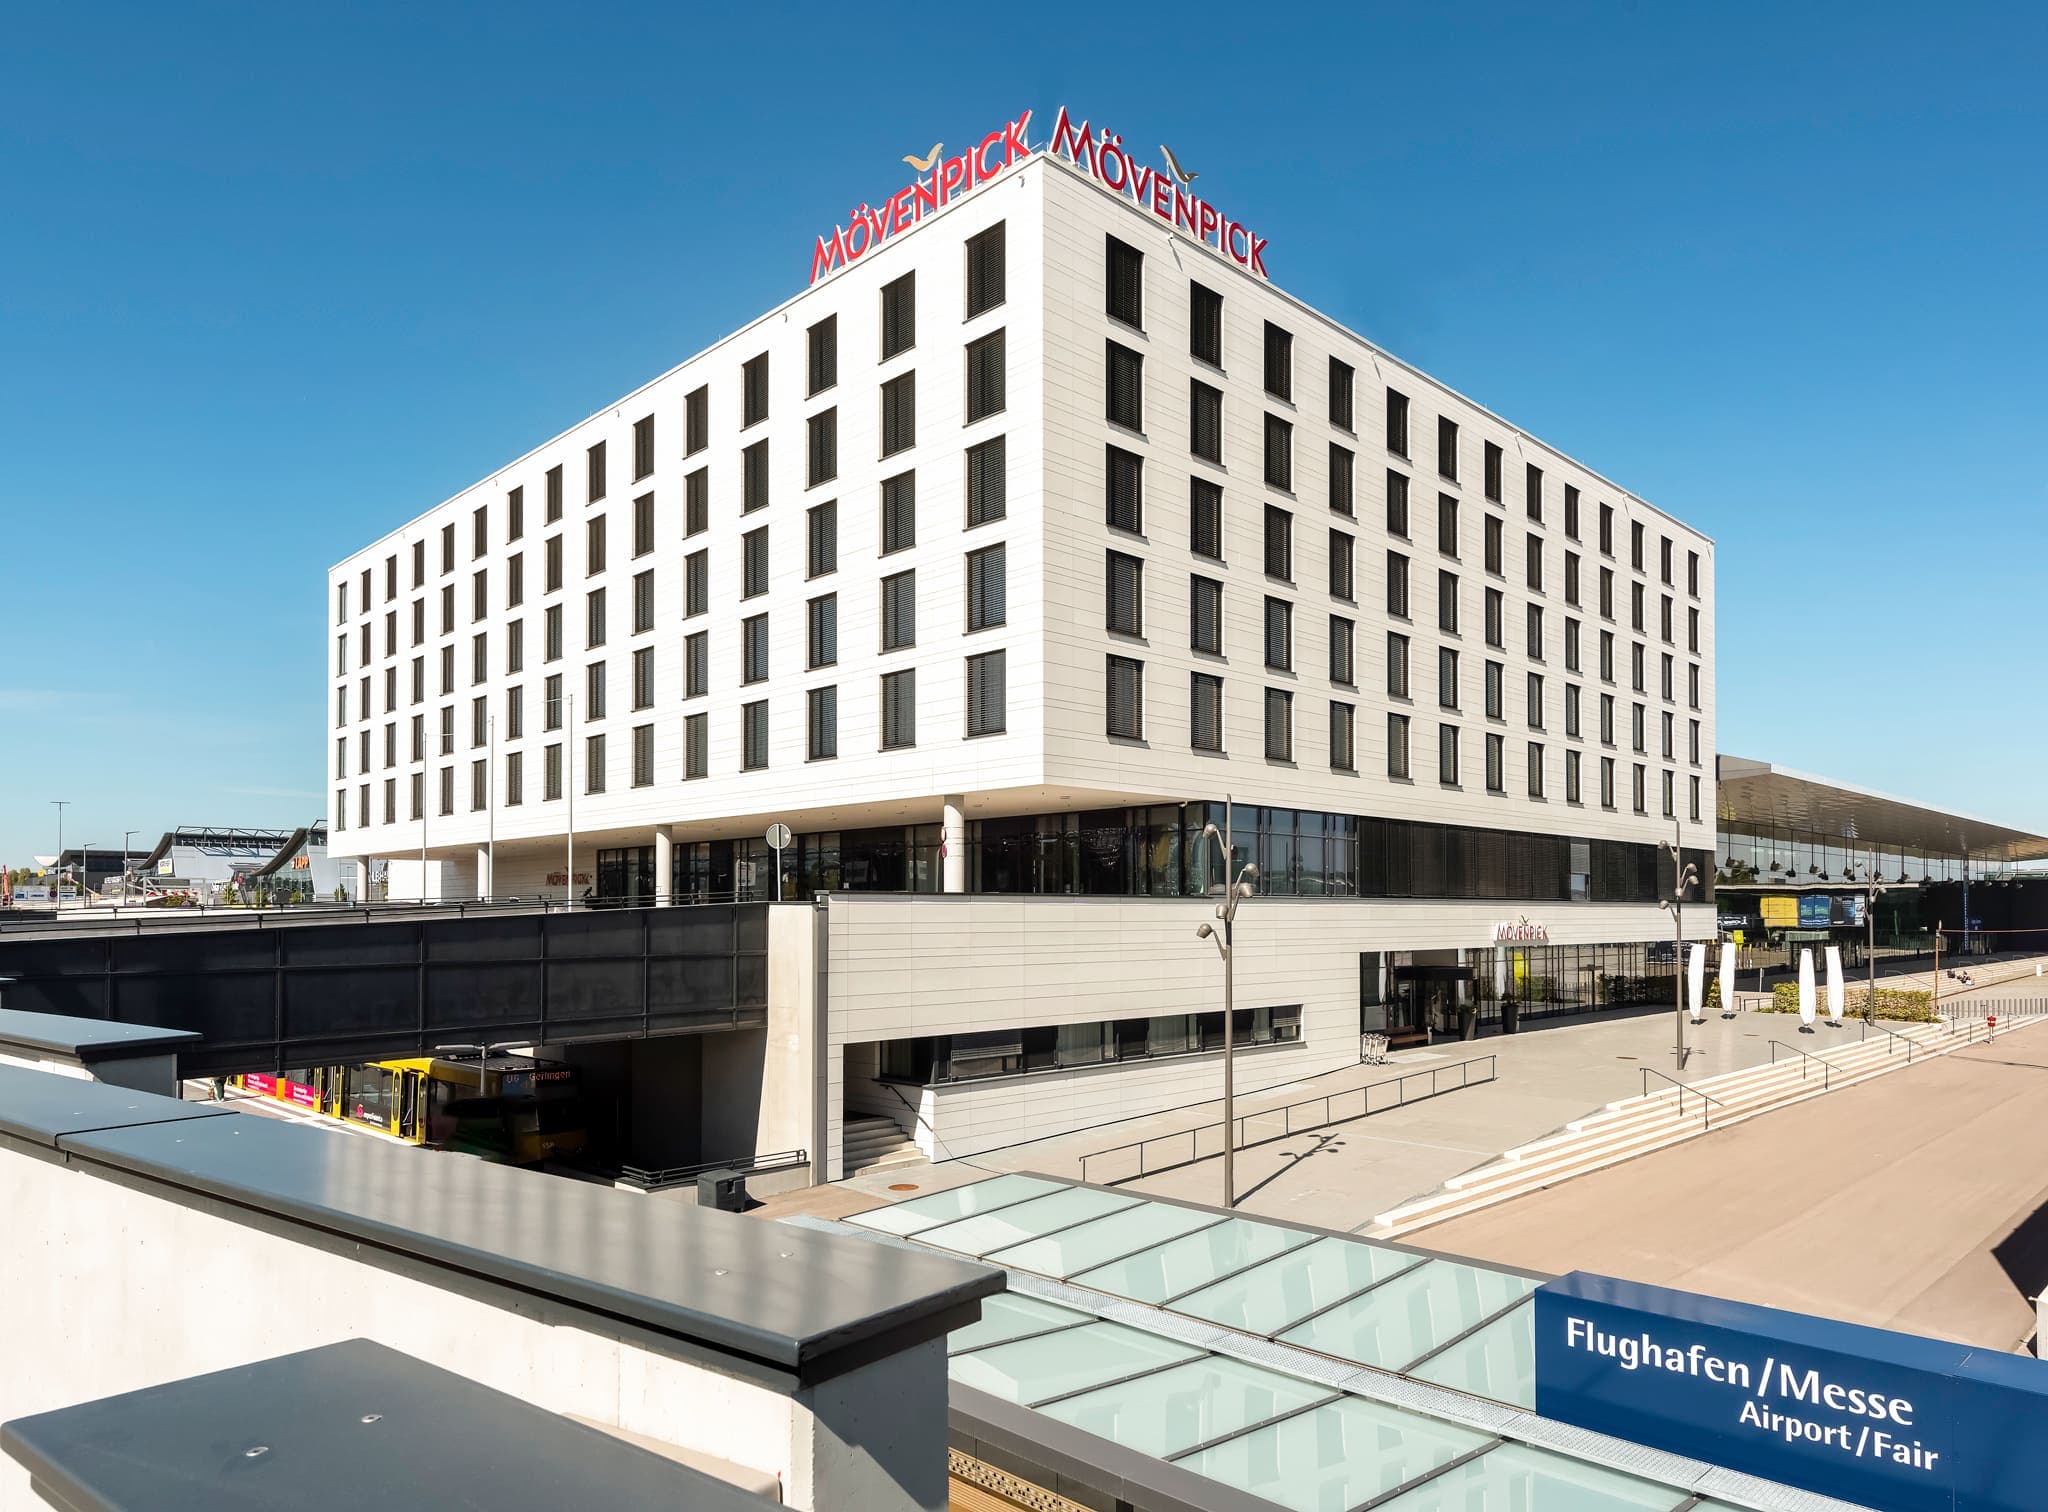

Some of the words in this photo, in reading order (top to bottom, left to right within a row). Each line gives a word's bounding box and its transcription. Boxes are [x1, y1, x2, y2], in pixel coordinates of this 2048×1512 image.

[810, 109, 1032, 285] MÖVENPICK
[1050, 105, 1268, 279] MÖVENPICK
[1496, 921, 1549, 941] MÖVENPICK
